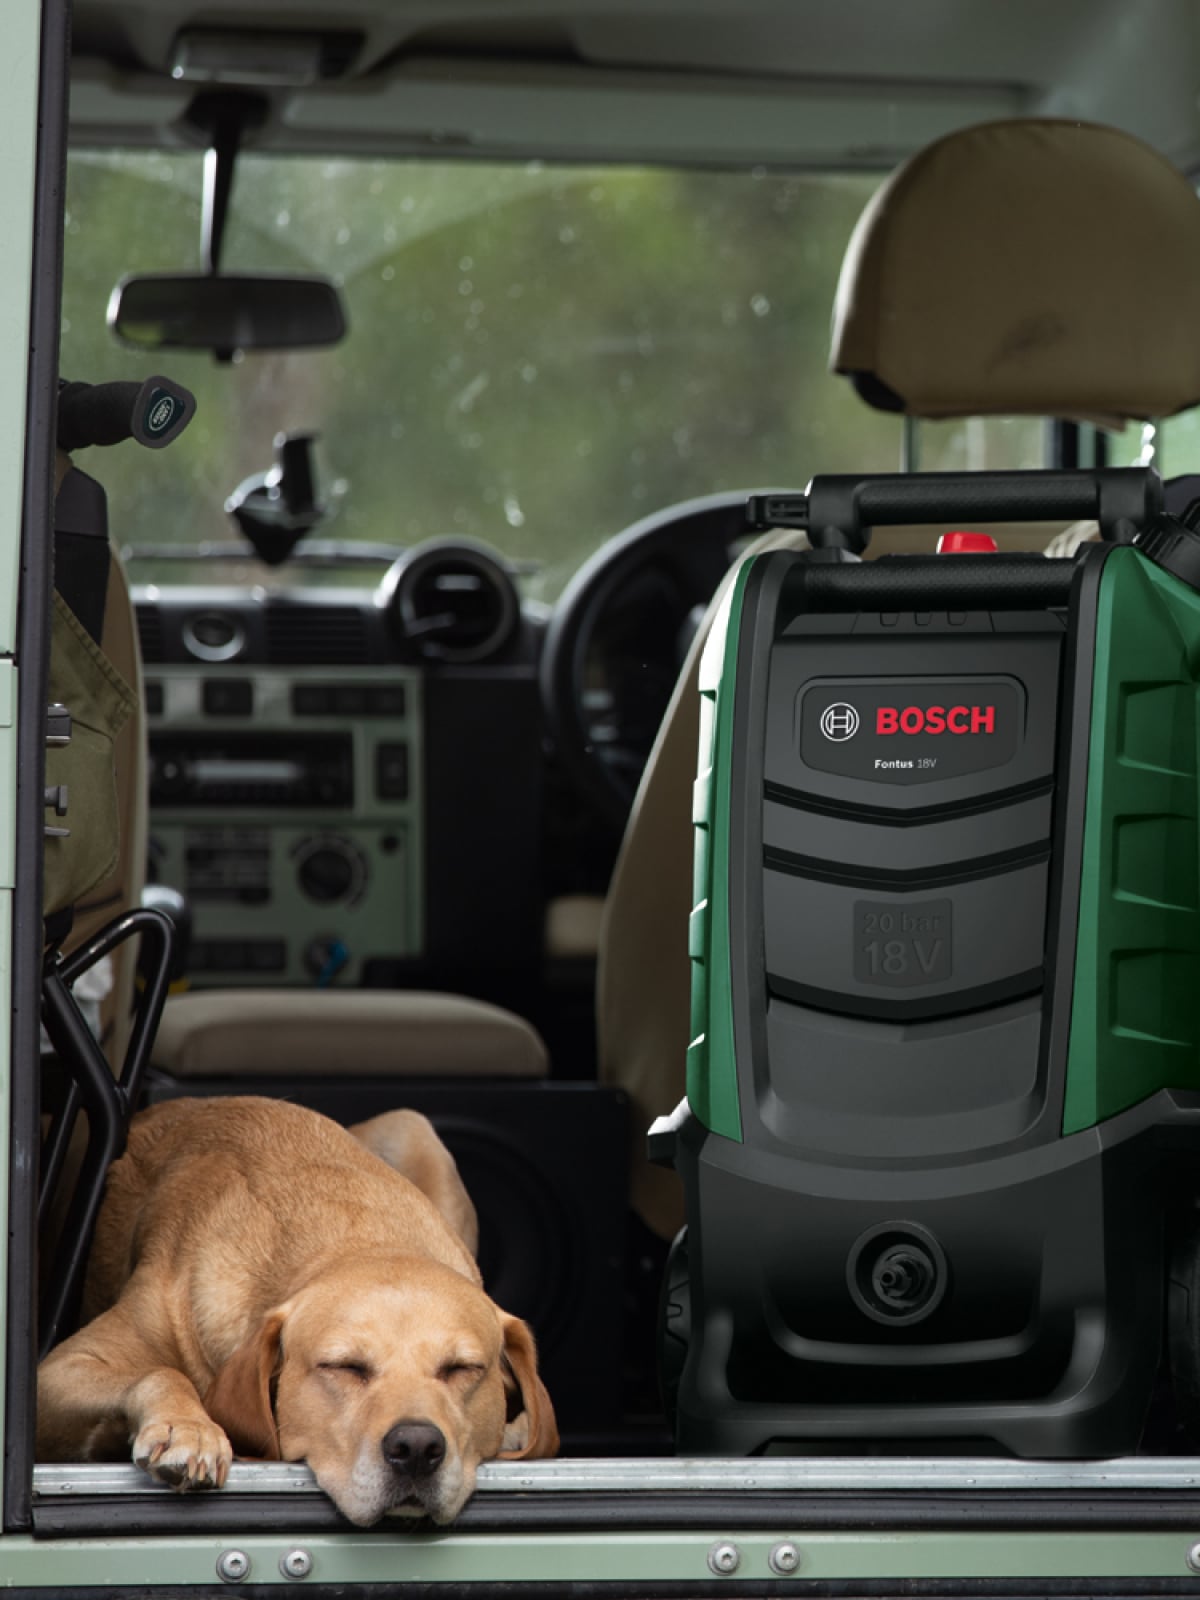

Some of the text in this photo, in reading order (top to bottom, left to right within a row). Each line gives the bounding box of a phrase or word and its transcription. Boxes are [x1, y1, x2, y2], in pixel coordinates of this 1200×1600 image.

[876, 705, 995, 735] BOSCH
[874, 758, 937, 769] Fontus 18V
[863, 911, 944, 934] 20 bar
